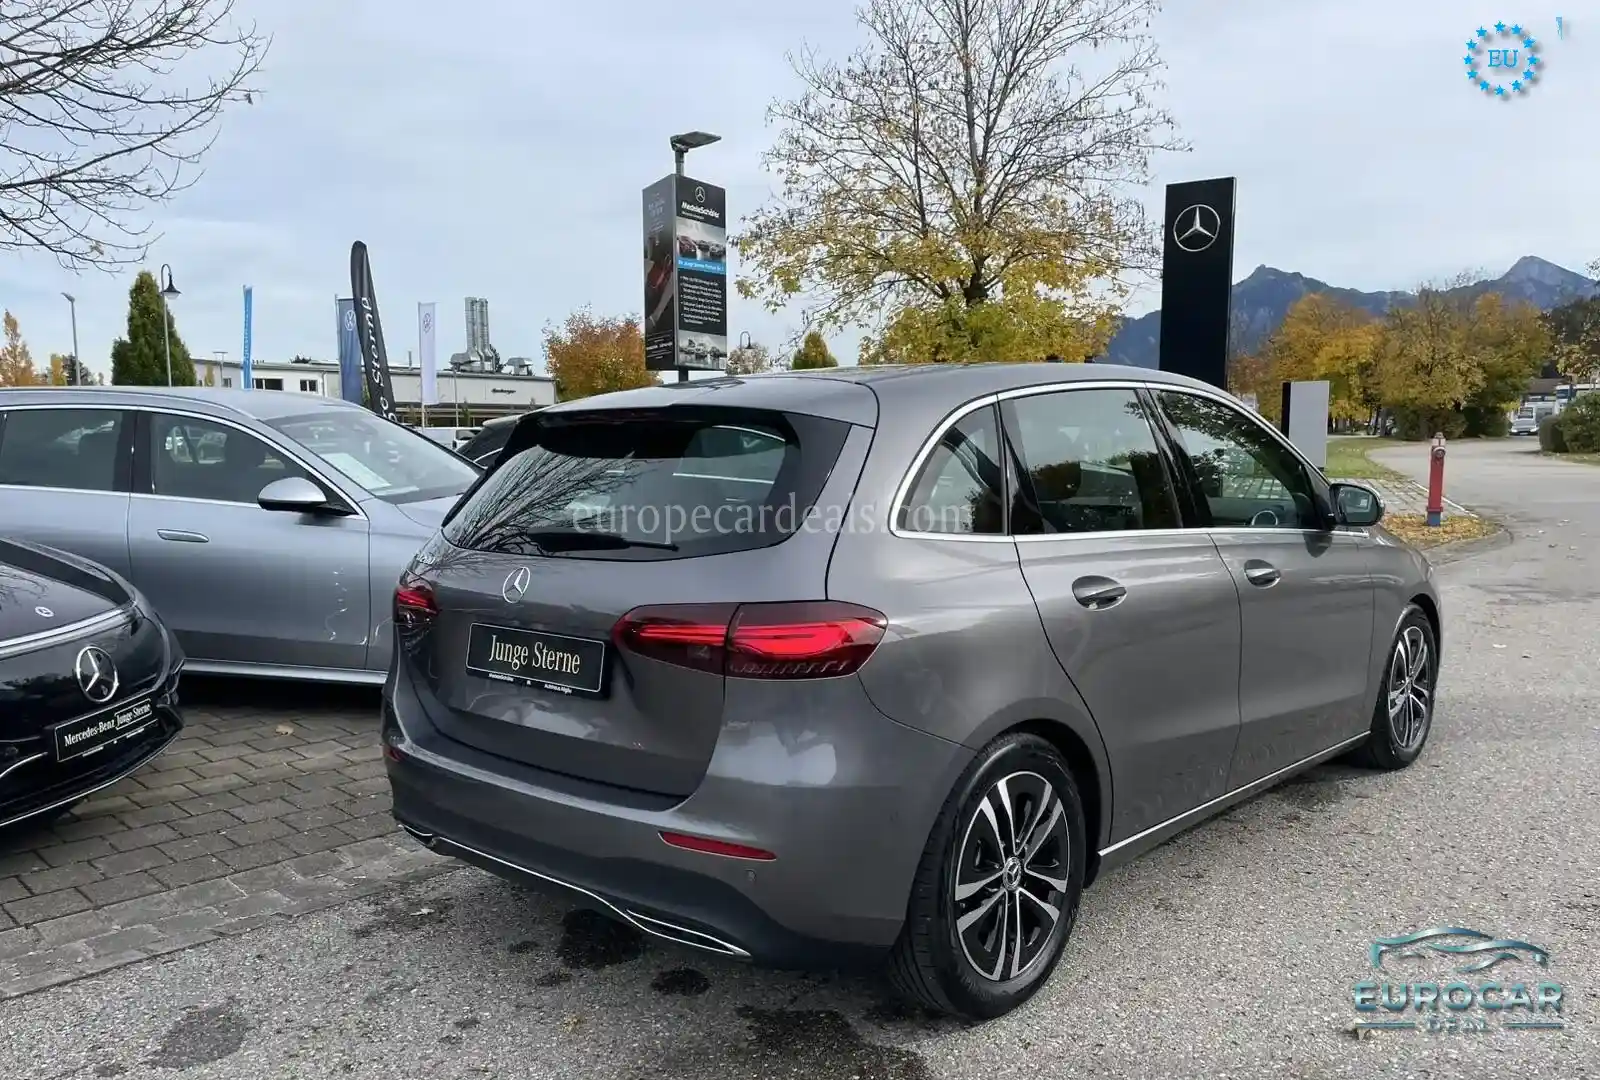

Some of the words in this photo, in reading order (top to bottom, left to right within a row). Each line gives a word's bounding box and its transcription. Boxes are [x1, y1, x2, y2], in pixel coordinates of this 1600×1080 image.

[488, 634, 529, 671] Junge
[532, 641, 581, 675] Sterne
[64, 718, 115, 747] Mercedes-Benz
[116, 711, 132, 727] Junge
[132, 703, 151, 718] Sterne
